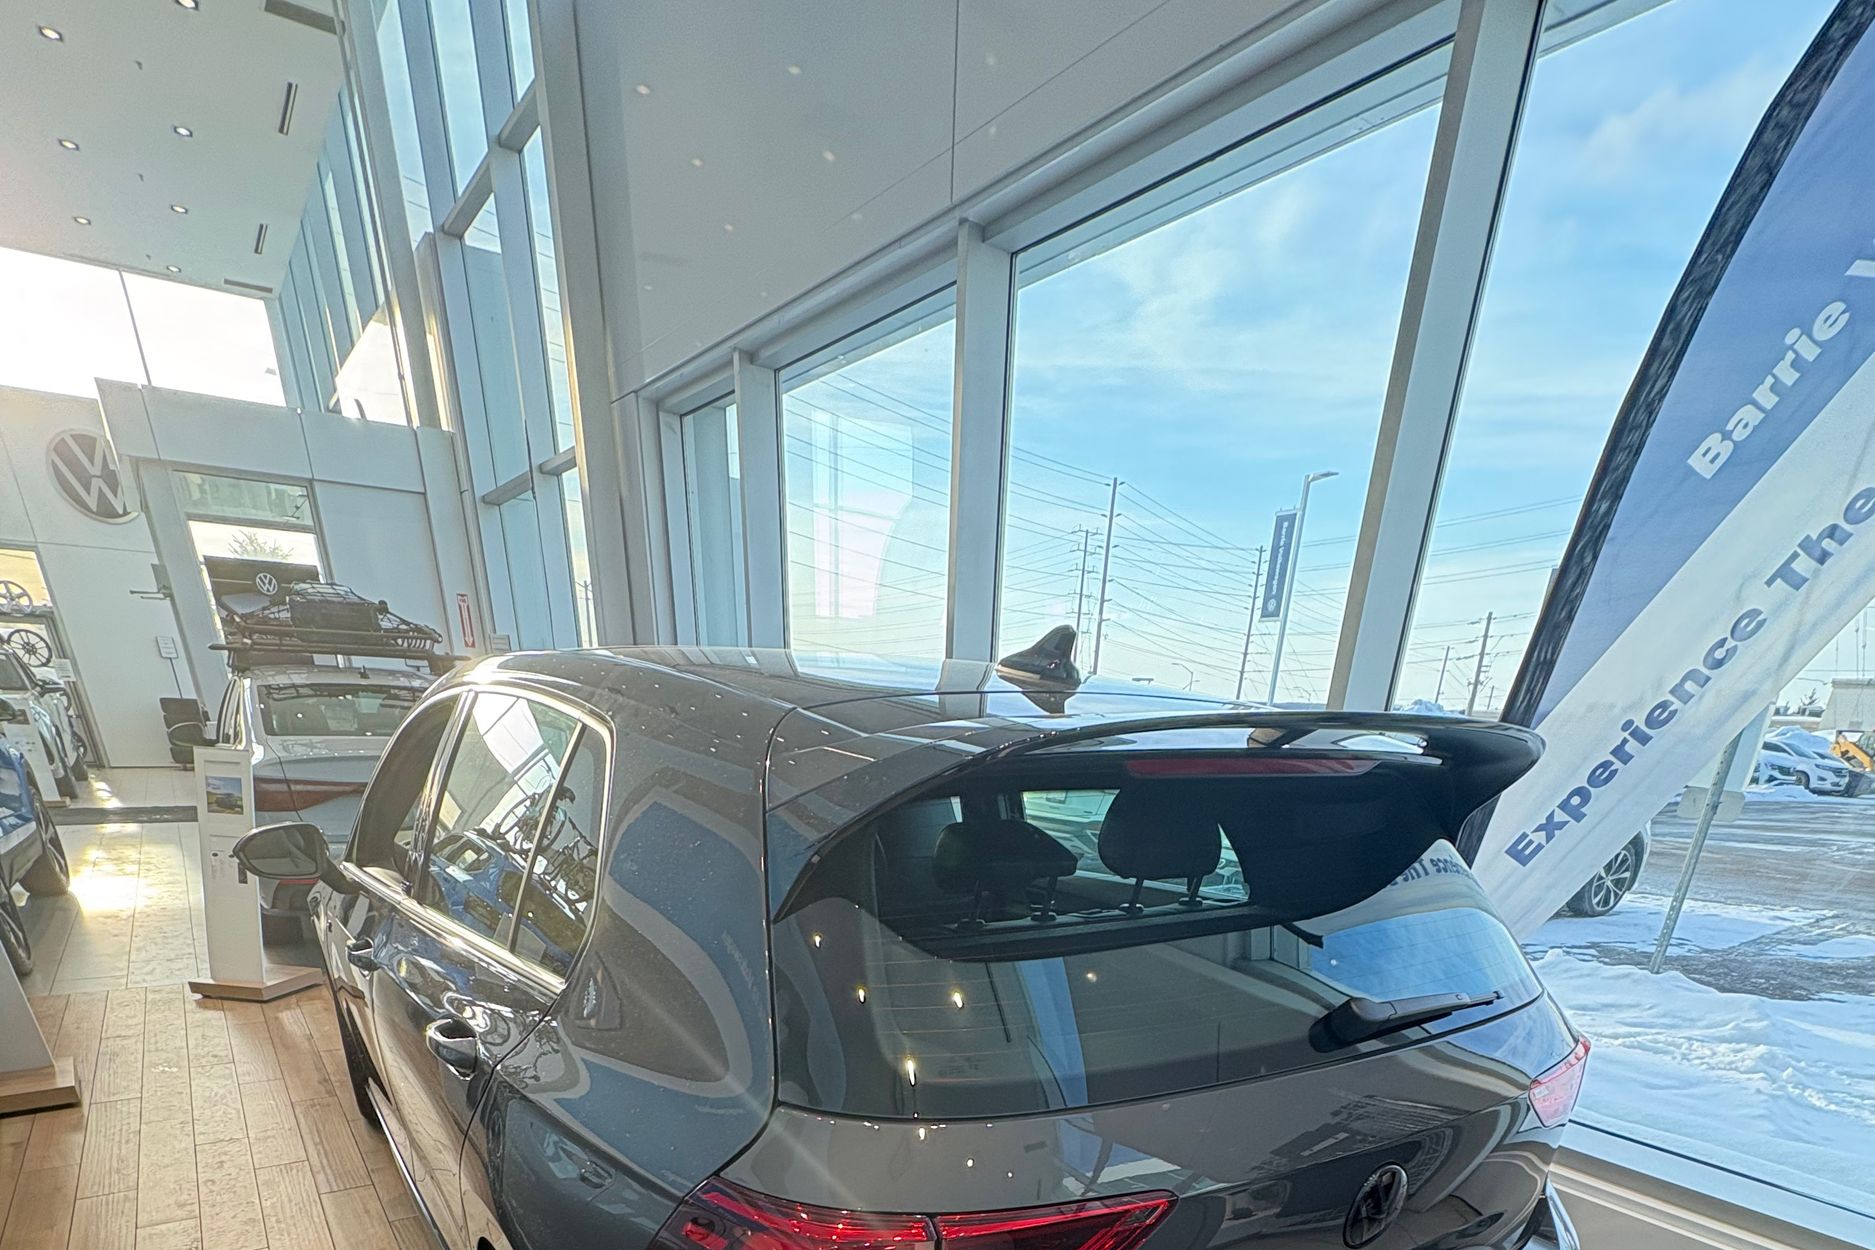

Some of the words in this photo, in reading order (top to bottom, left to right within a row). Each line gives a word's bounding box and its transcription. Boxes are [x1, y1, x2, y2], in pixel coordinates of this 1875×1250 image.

[1687, 301, 1850, 480] Barrie
[256, 573, 278, 595] VW
[1505, 608, 1768, 867] Experience
[1764, 487, 1875, 592] The
